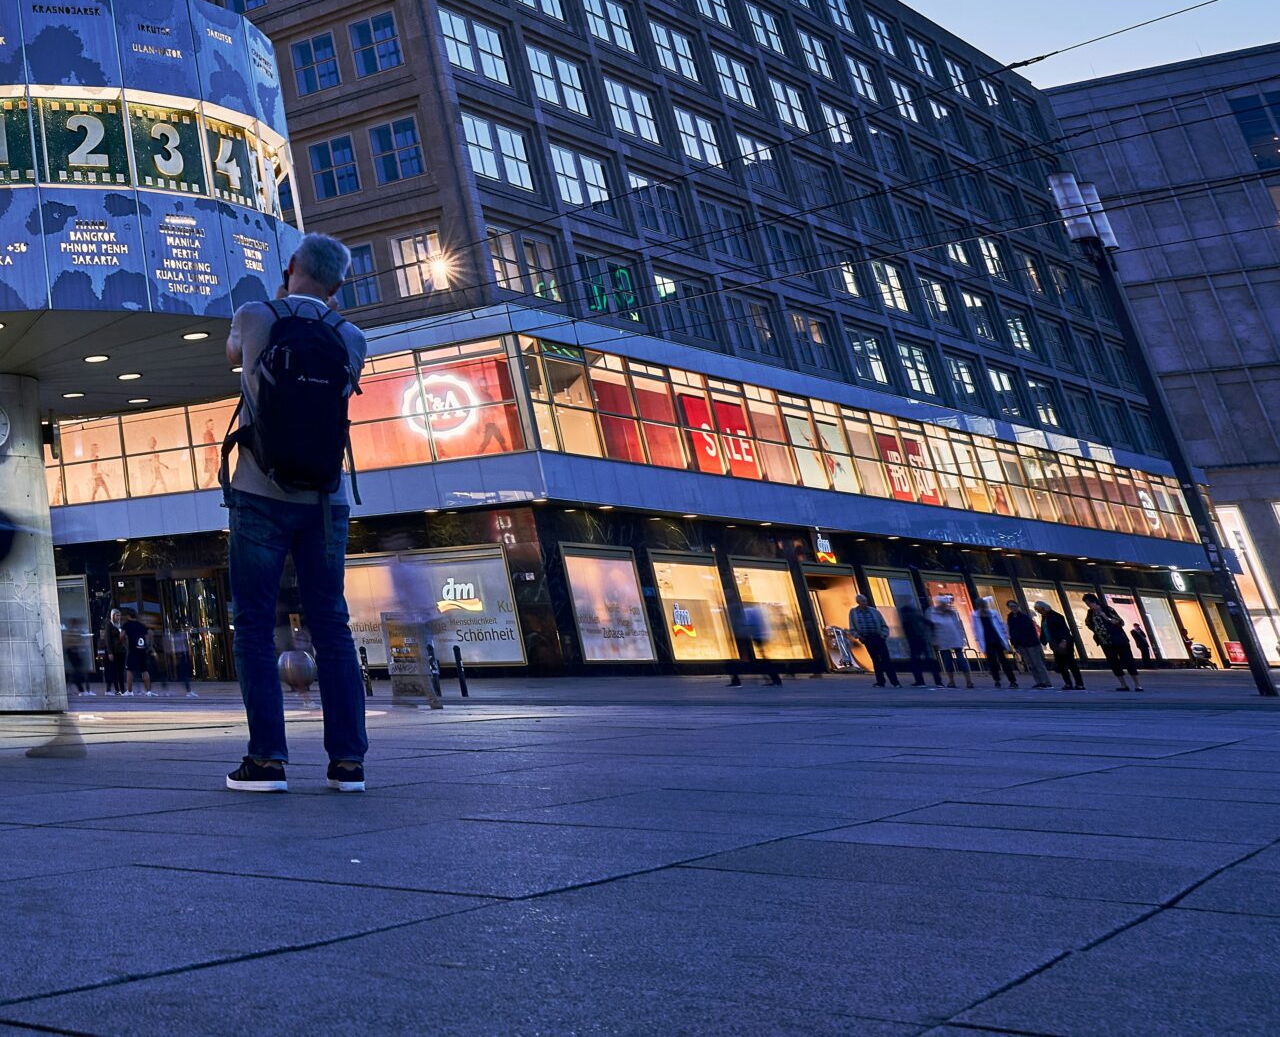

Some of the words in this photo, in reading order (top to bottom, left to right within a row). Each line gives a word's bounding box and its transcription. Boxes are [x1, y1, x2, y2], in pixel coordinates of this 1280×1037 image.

[32, 4, 101, 17] KRASNOJARSK
[138, 23, 171, 36] IRKUTSK
[206, 28, 233, 45] JAKUTSK
[66, 115, 109, 167] 2
[150, 123, 184, 176] 3
[215, 138, 241, 190] 4
[69, 231, 117, 242] BANGKOK
[166, 236, 201, 249] MANILA
[60, 243, 97, 253] PHNOM
[101, 244, 129, 254] PENH
[171, 248, 199, 260] PERTH
[71, 254, 120, 266] JAKARTA
[163, 258, 211, 273] HONGKONG
[244, 258, 265, 272] SEOUL
[155, 269, 185, 282] KUALA
[168, 282, 211, 296] SINGAUR
[442, 578, 475, 601] dm
[456, 627, 516, 642] Schönheit
